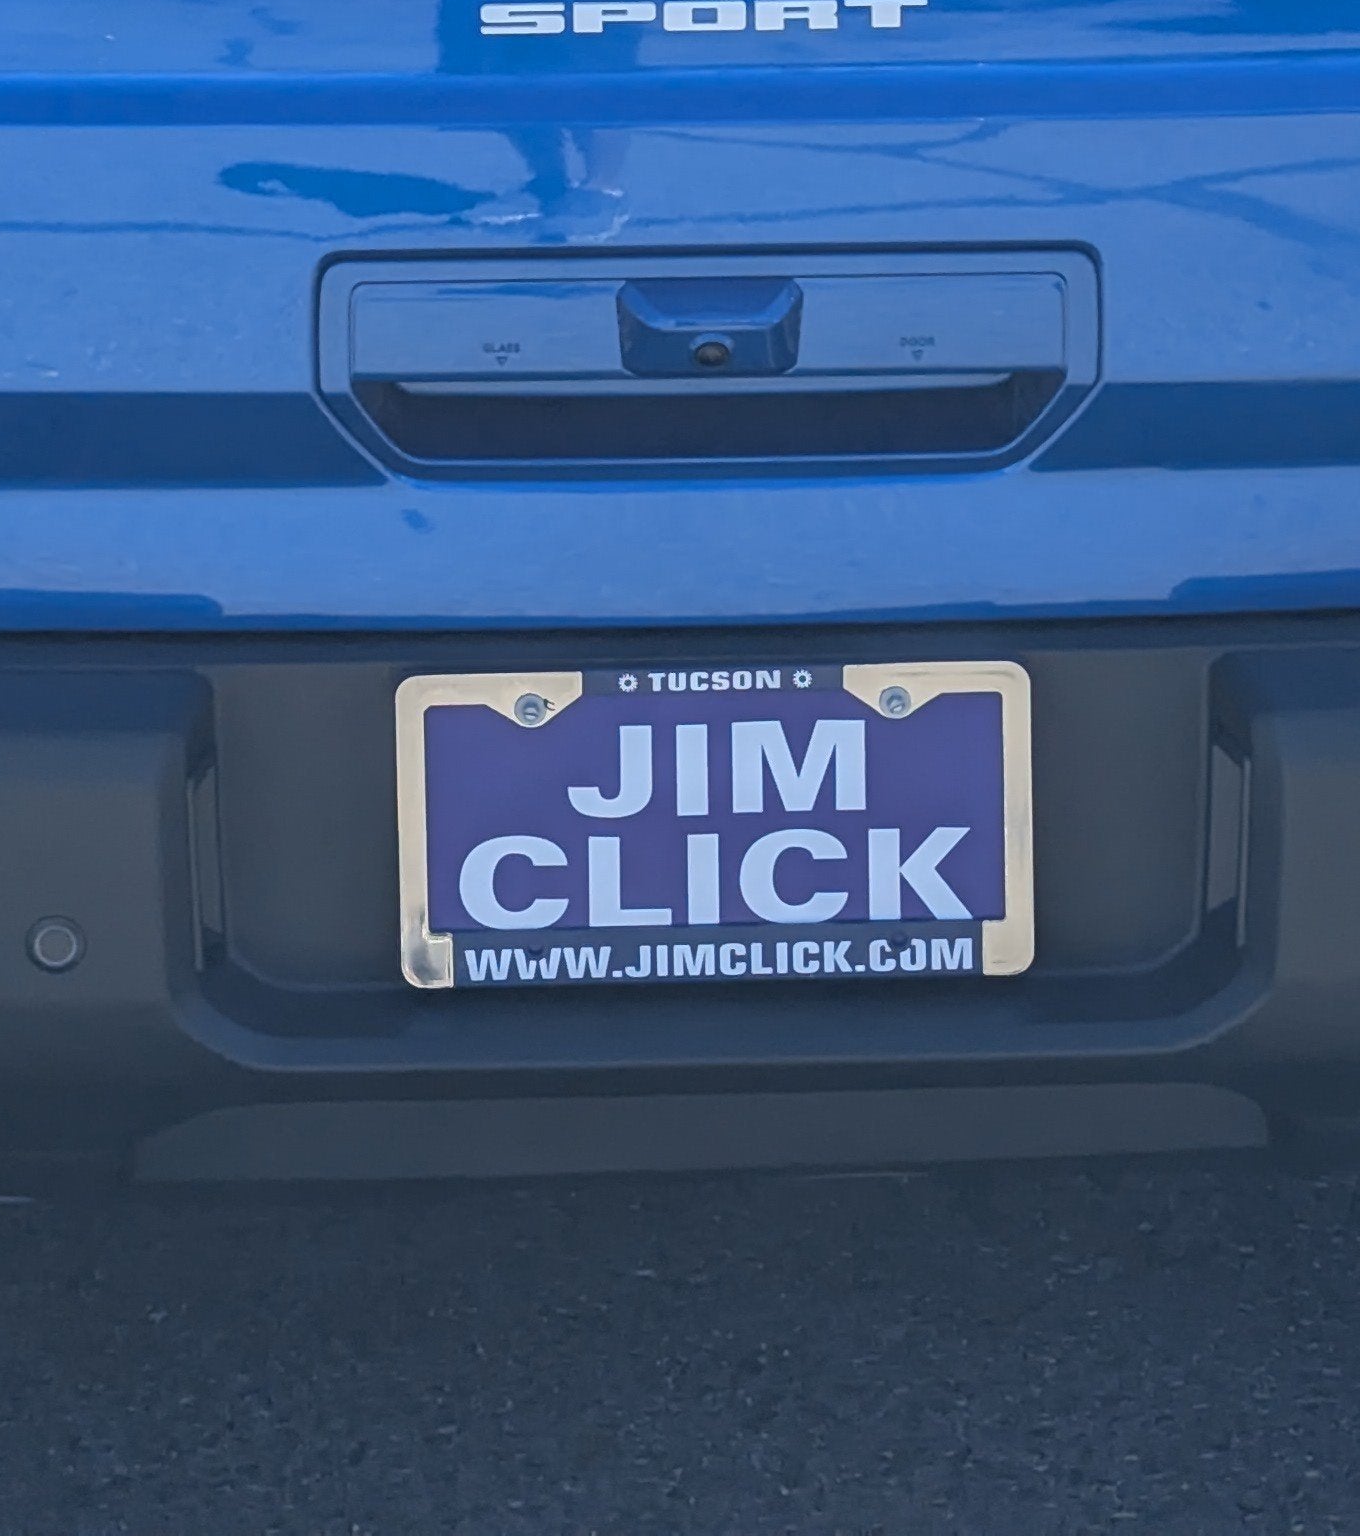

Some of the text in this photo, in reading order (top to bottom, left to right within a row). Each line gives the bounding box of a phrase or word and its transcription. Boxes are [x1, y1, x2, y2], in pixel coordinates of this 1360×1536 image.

[647, 669, 782, 693] TUCSON
[566, 718, 867, 819] JIM
[458, 826, 974, 930] CLICK
[464, 936, 974, 983] WWW.JIMCLICK.COM
